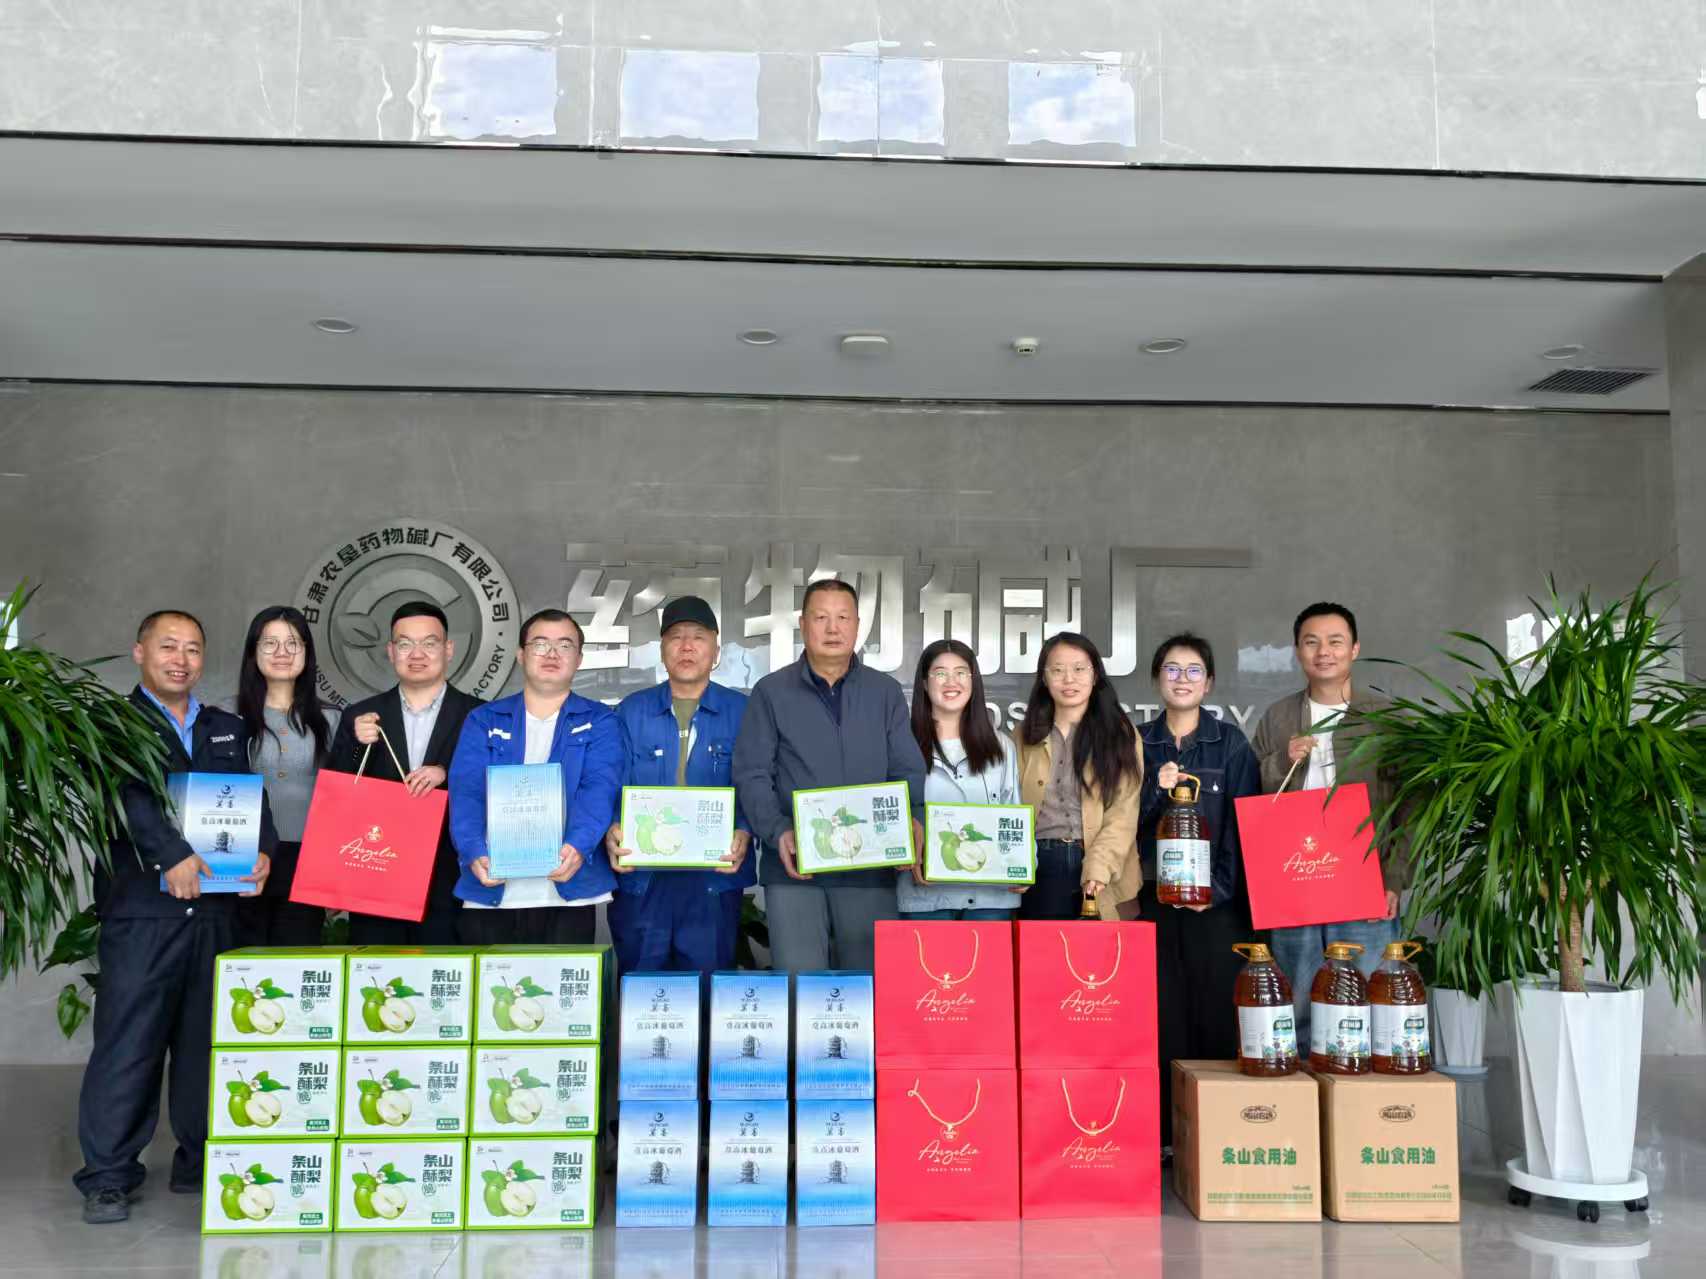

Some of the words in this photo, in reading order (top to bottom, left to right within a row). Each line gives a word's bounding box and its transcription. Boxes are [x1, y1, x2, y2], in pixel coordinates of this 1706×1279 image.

[302, 527, 510, 624] 甘肃农垦药物碱厂有限公司
[468, 644, 505, 698] ACTORY
[302, 970, 331, 984] 条山
[431, 969, 461, 983] 条山
[560, 968, 590, 982] 条山
[298, 1061, 328, 1076] 条山
[428, 1060, 459, 1075] 条山
[557, 1059, 588, 1074] 条山
[291, 1154, 322, 1169] 条山
[422, 1153, 454, 1168] 条山
[552, 1151, 583, 1166] 条山
[1222, 1147, 1297, 1166] 条山食用油
[1360, 1146, 1436, 1165] 条山食用油
